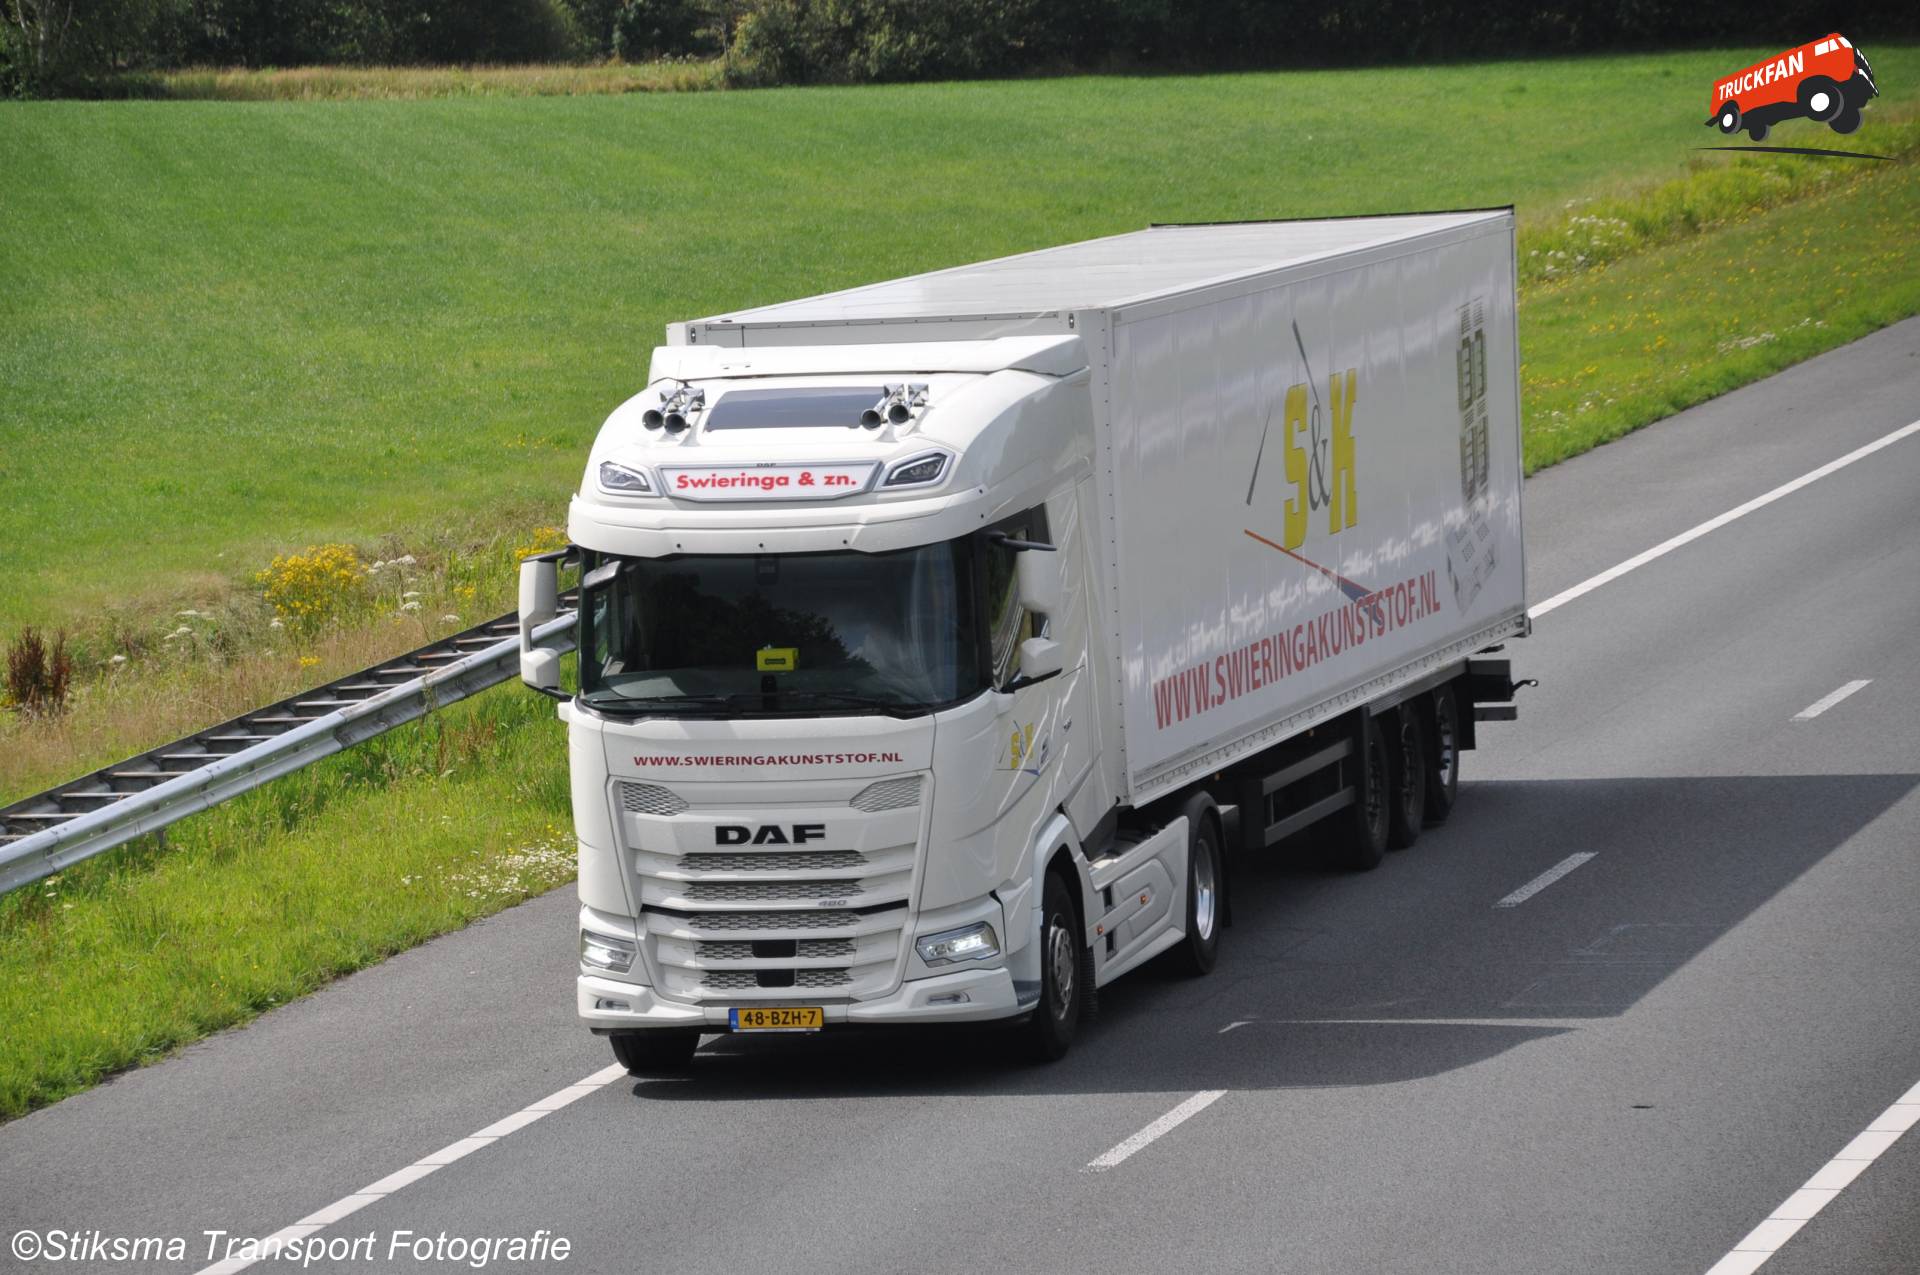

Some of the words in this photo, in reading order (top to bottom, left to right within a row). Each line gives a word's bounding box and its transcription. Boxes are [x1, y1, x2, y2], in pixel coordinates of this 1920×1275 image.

[1284, 367, 1357, 553] S&K
[677, 473, 789, 491] Swieringa
[798, 472, 815, 487] &
[823, 473, 857, 486] zn.
[1154, 569, 1441, 731] WWW.SWIERINGAKUNSTSTOF.NL
[634, 752, 903, 767] WWW.SWIERINGAKUNSTSTOF.NL
[715, 824, 826, 846] DAF
[743, 1010, 818, 1026] 48-BZH-7
